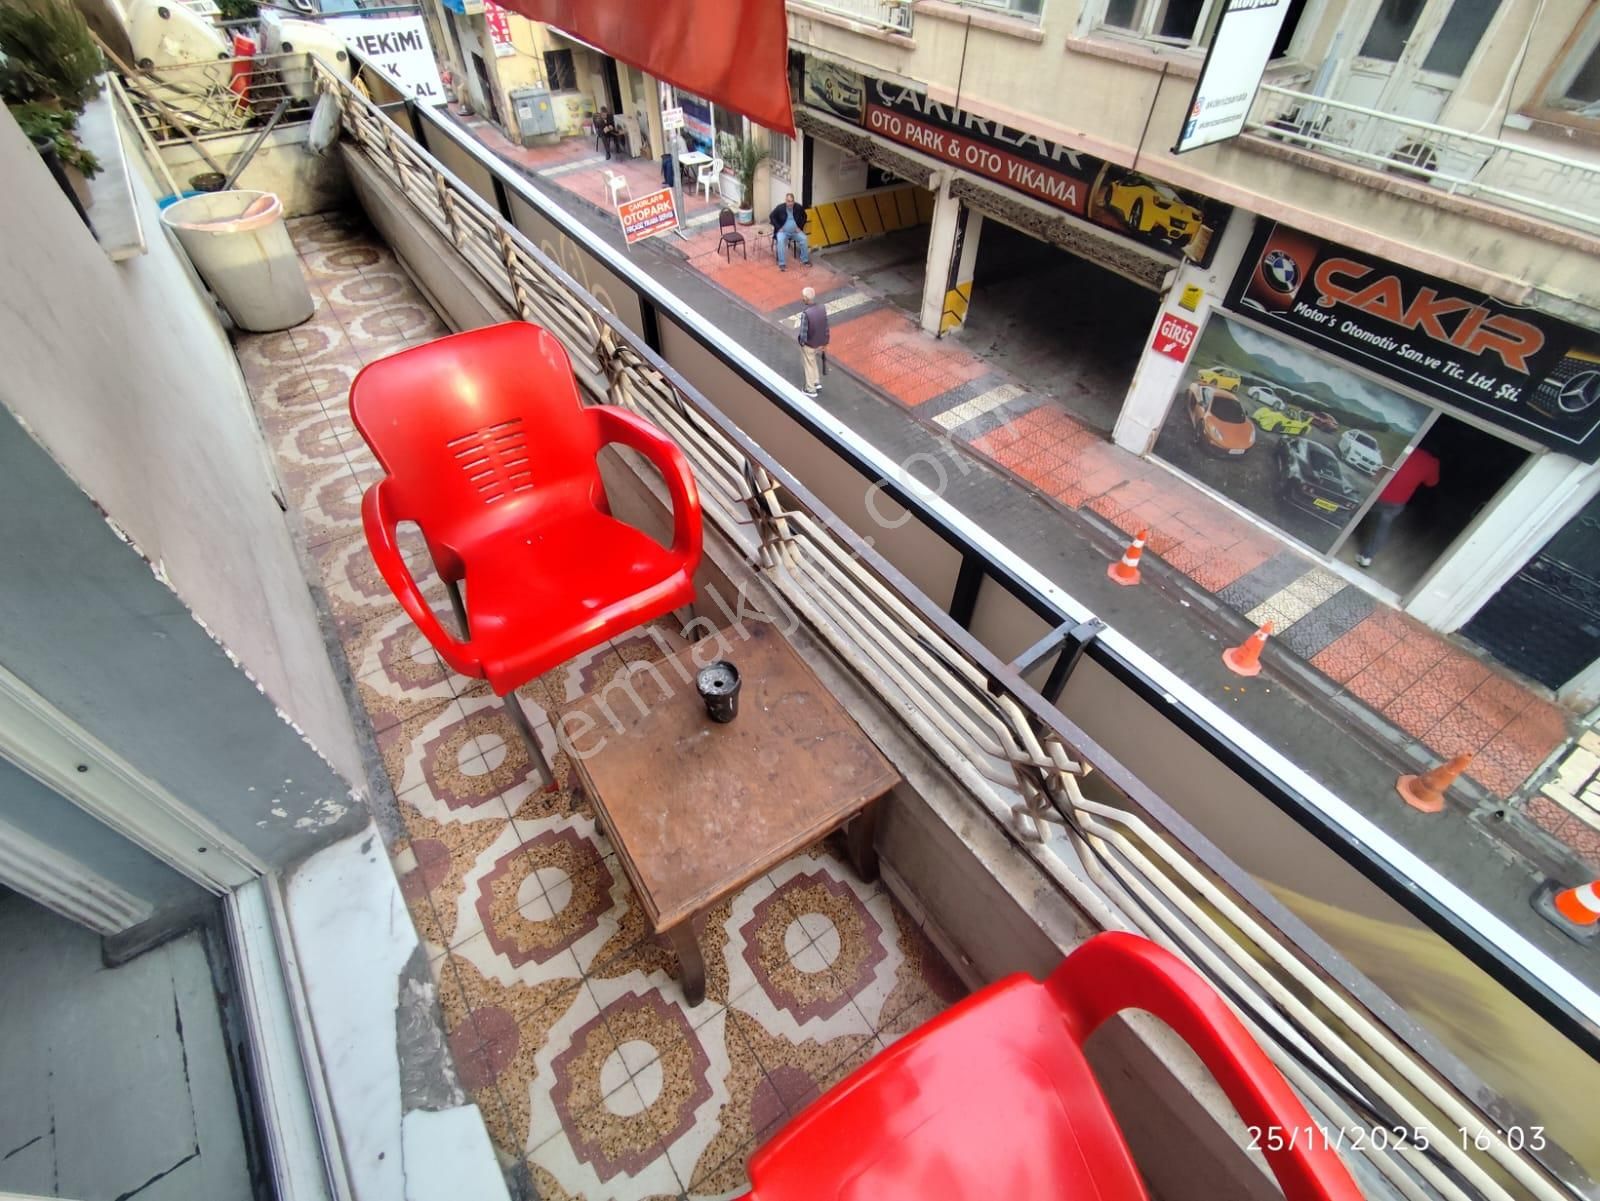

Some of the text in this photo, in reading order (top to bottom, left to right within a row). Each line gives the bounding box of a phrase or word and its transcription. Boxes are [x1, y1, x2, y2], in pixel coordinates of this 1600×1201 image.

[871, 110, 1076, 206] OTO PARK & OTO YIKAMA
[623, 200, 672, 226] OTOPARK
[1161, 319, 1192, 348] GİRİŞ
[1293, 302, 1337, 327] Motor's
[1340, 321, 1398, 351] Otomotiv
[1441, 360, 1464, 380] Tic.
[1466, 371, 1496, 392] Ltd.
[1494, 383, 1522, 402] Şti.
[1314, 258, 1545, 376] ÇAKIR
